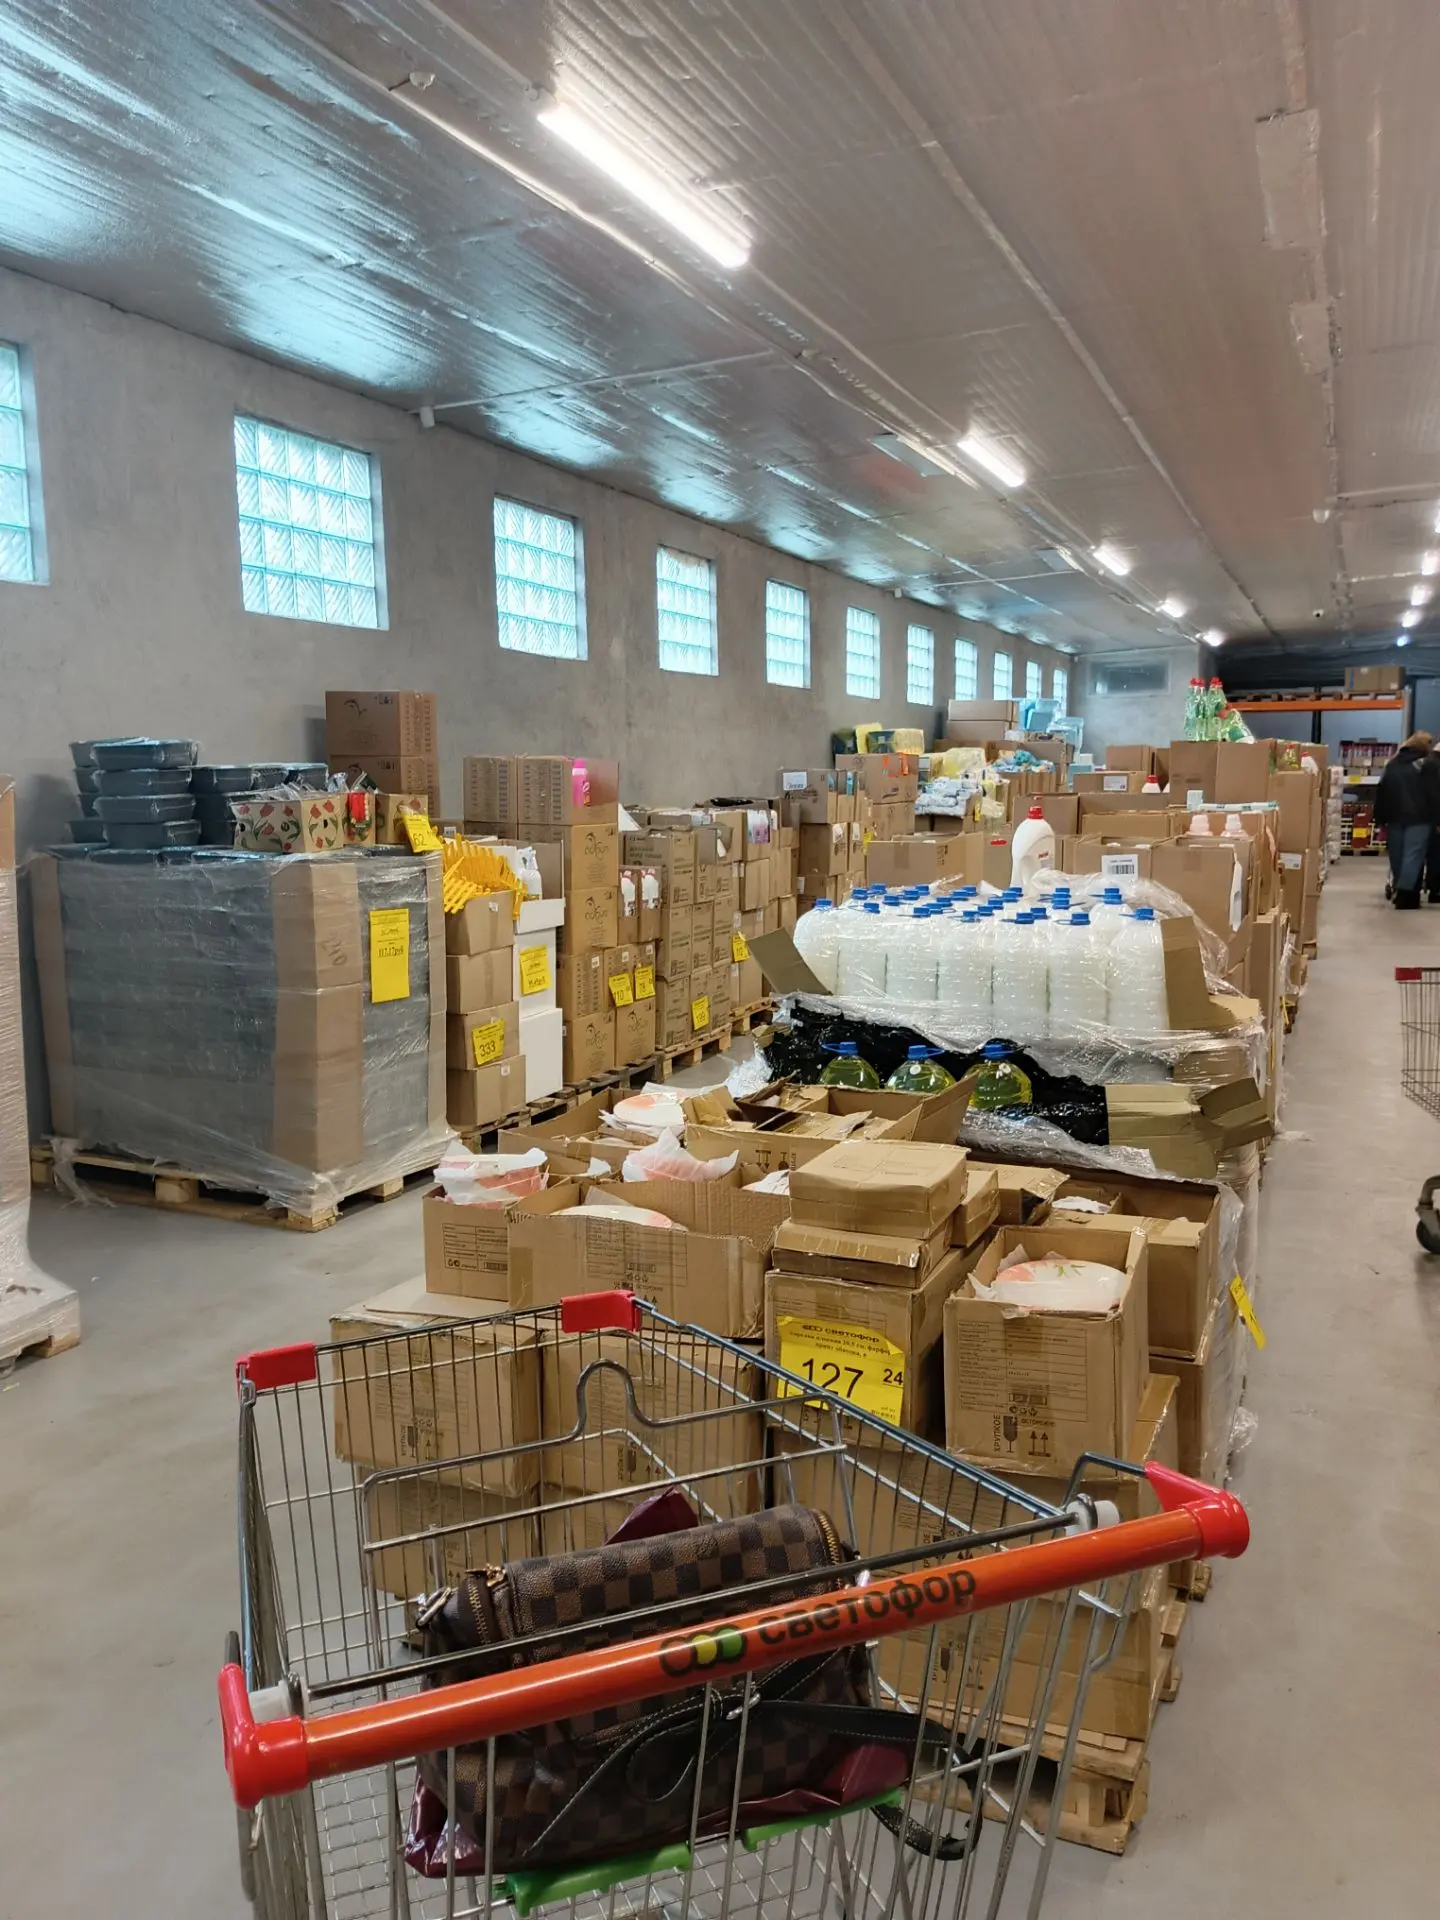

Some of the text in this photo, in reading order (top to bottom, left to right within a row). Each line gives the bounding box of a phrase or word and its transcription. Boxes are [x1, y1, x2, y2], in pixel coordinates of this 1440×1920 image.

[479, 1040, 496, 1057] 333
[802, 1357, 864, 1399] 127
[883, 1368, 904, 1386] 24
